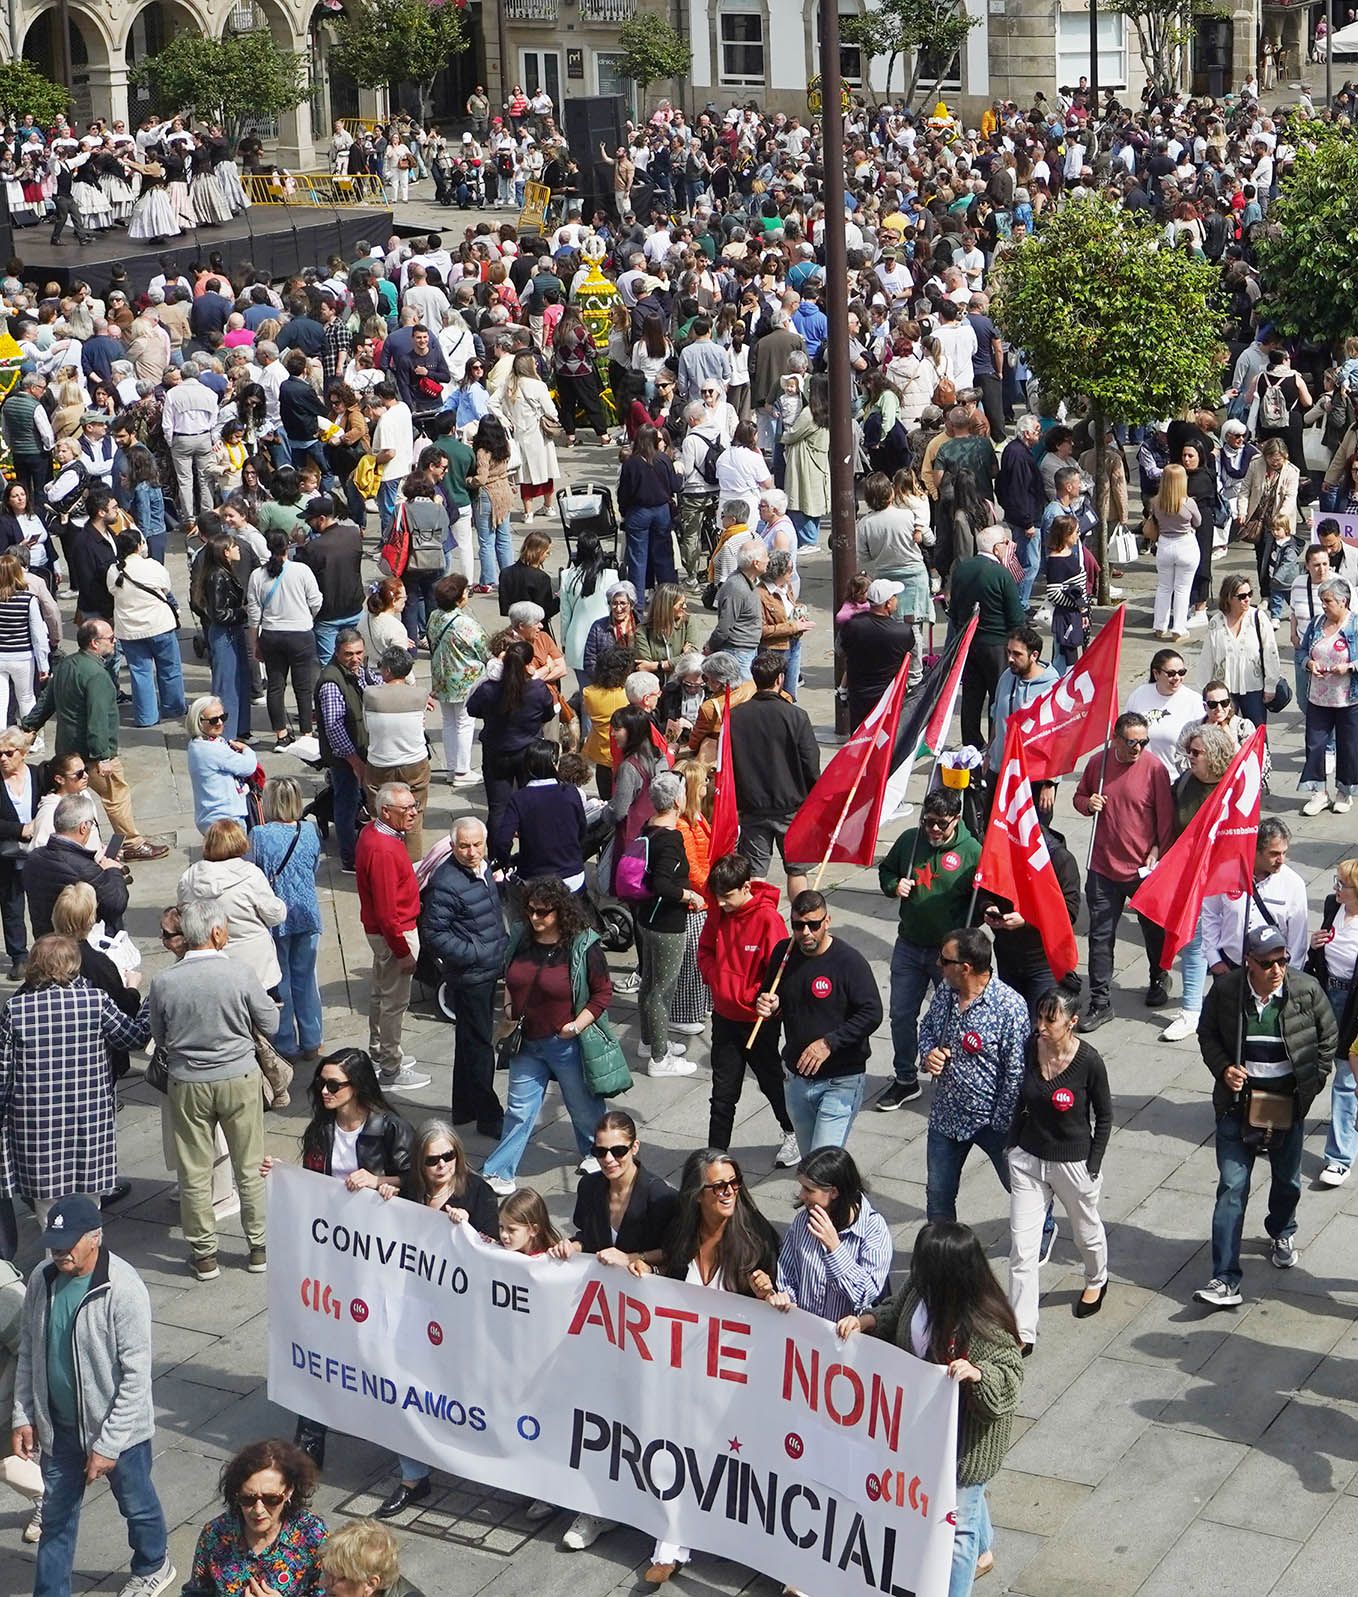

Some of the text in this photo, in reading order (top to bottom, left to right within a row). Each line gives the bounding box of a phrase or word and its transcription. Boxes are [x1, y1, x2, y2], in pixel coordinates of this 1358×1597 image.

[301, 1277, 341, 1320] CIG
[311, 1217, 904, 1453] CONVENIO DE ARTE NON
[291, 1341, 917, 1597] DEFENDAMOS O PROVINCIAL
[880, 1468, 928, 1518] CIG
